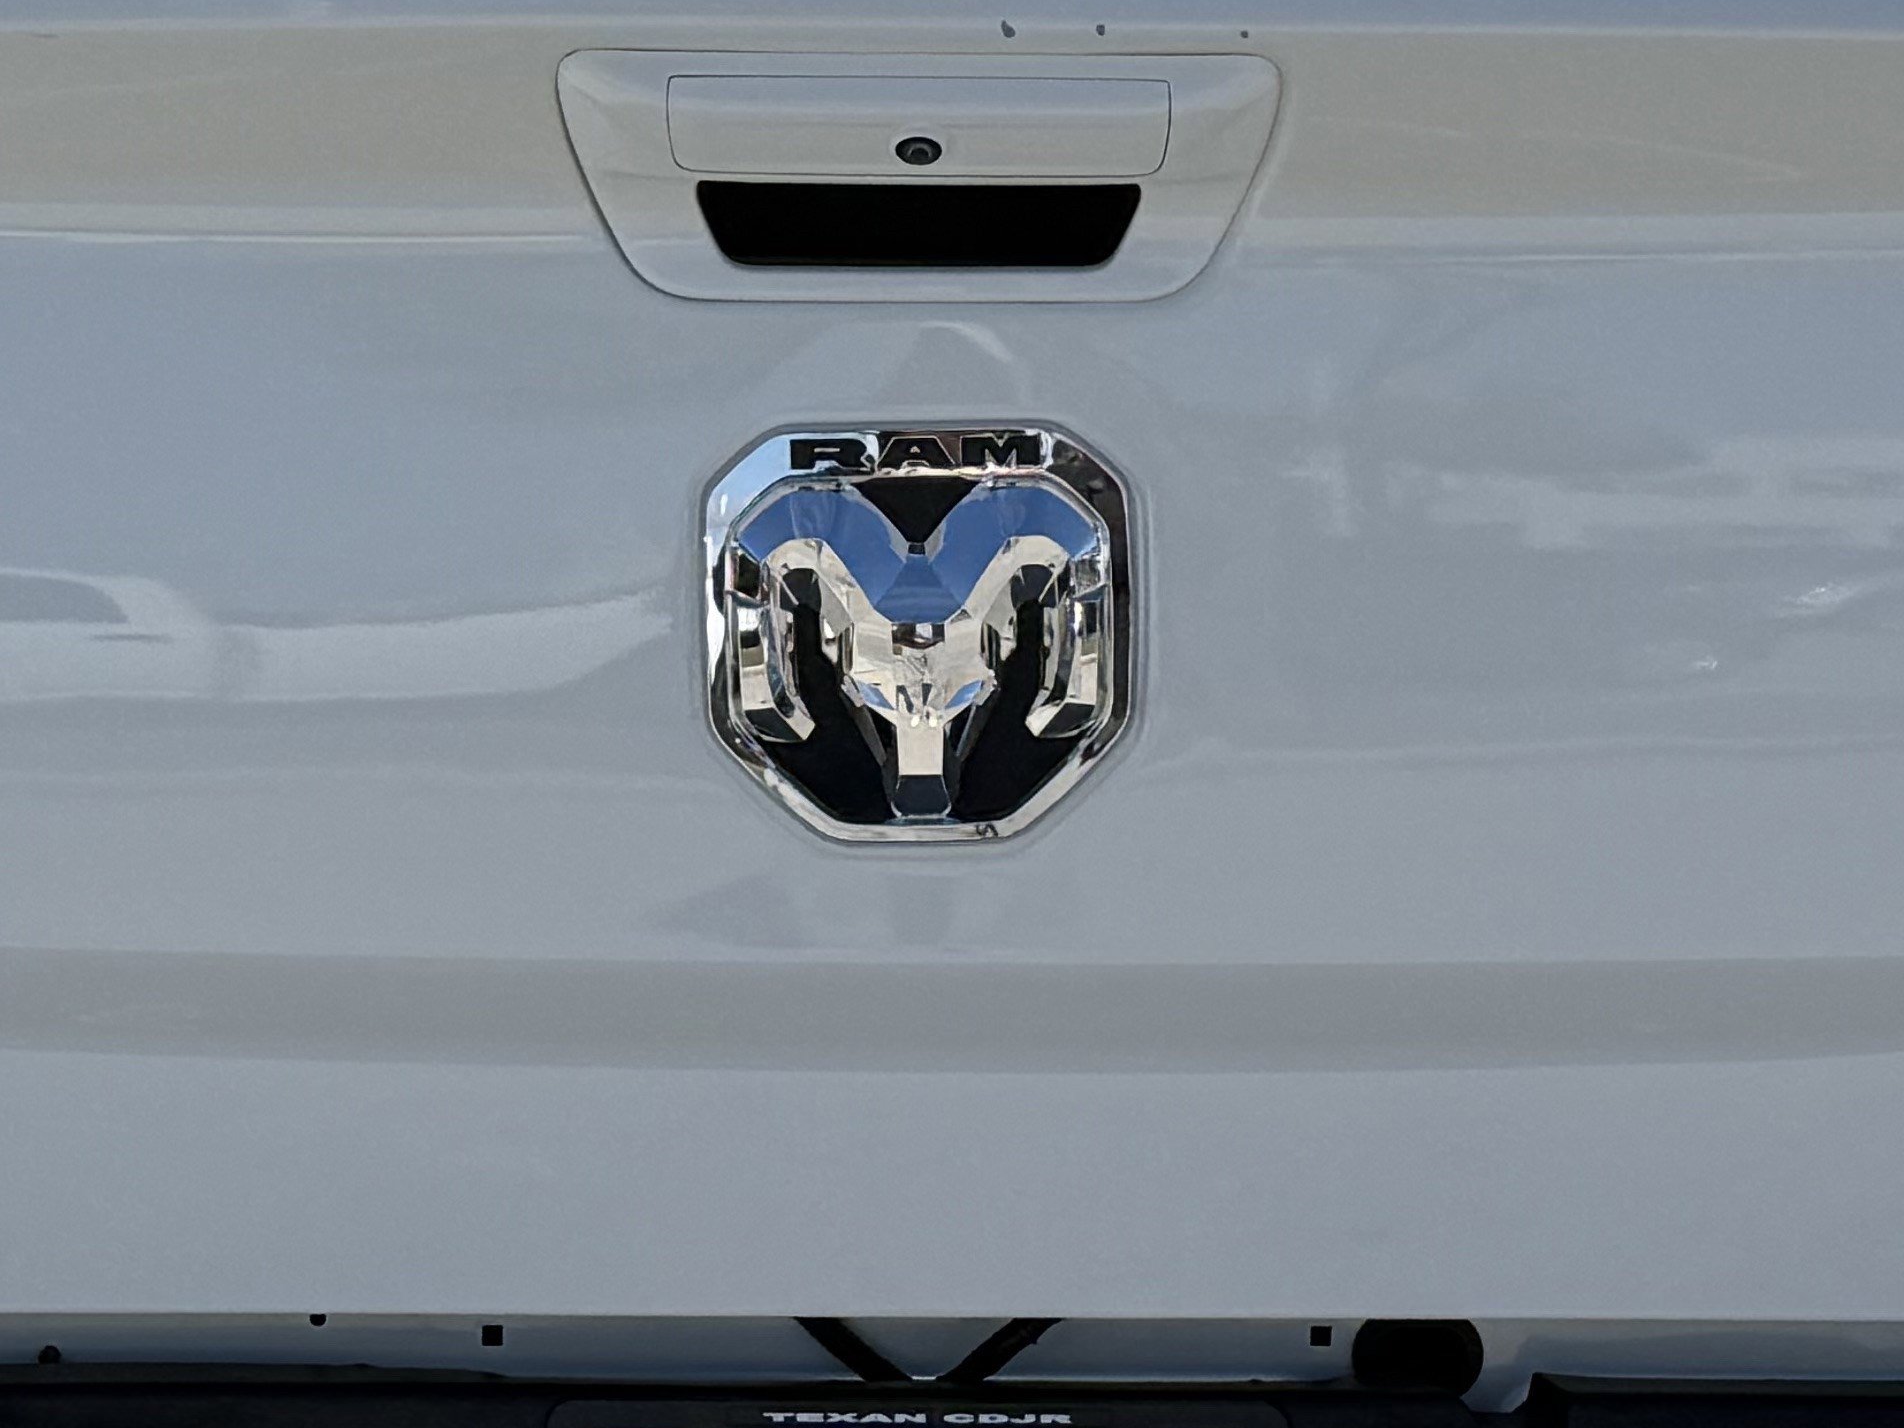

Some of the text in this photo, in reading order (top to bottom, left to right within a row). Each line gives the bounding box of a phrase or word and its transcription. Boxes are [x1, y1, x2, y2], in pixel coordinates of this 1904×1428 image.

[789, 436, 1042, 470] RAM
[762, 1411, 1072, 1425] TEXAN CDJR
